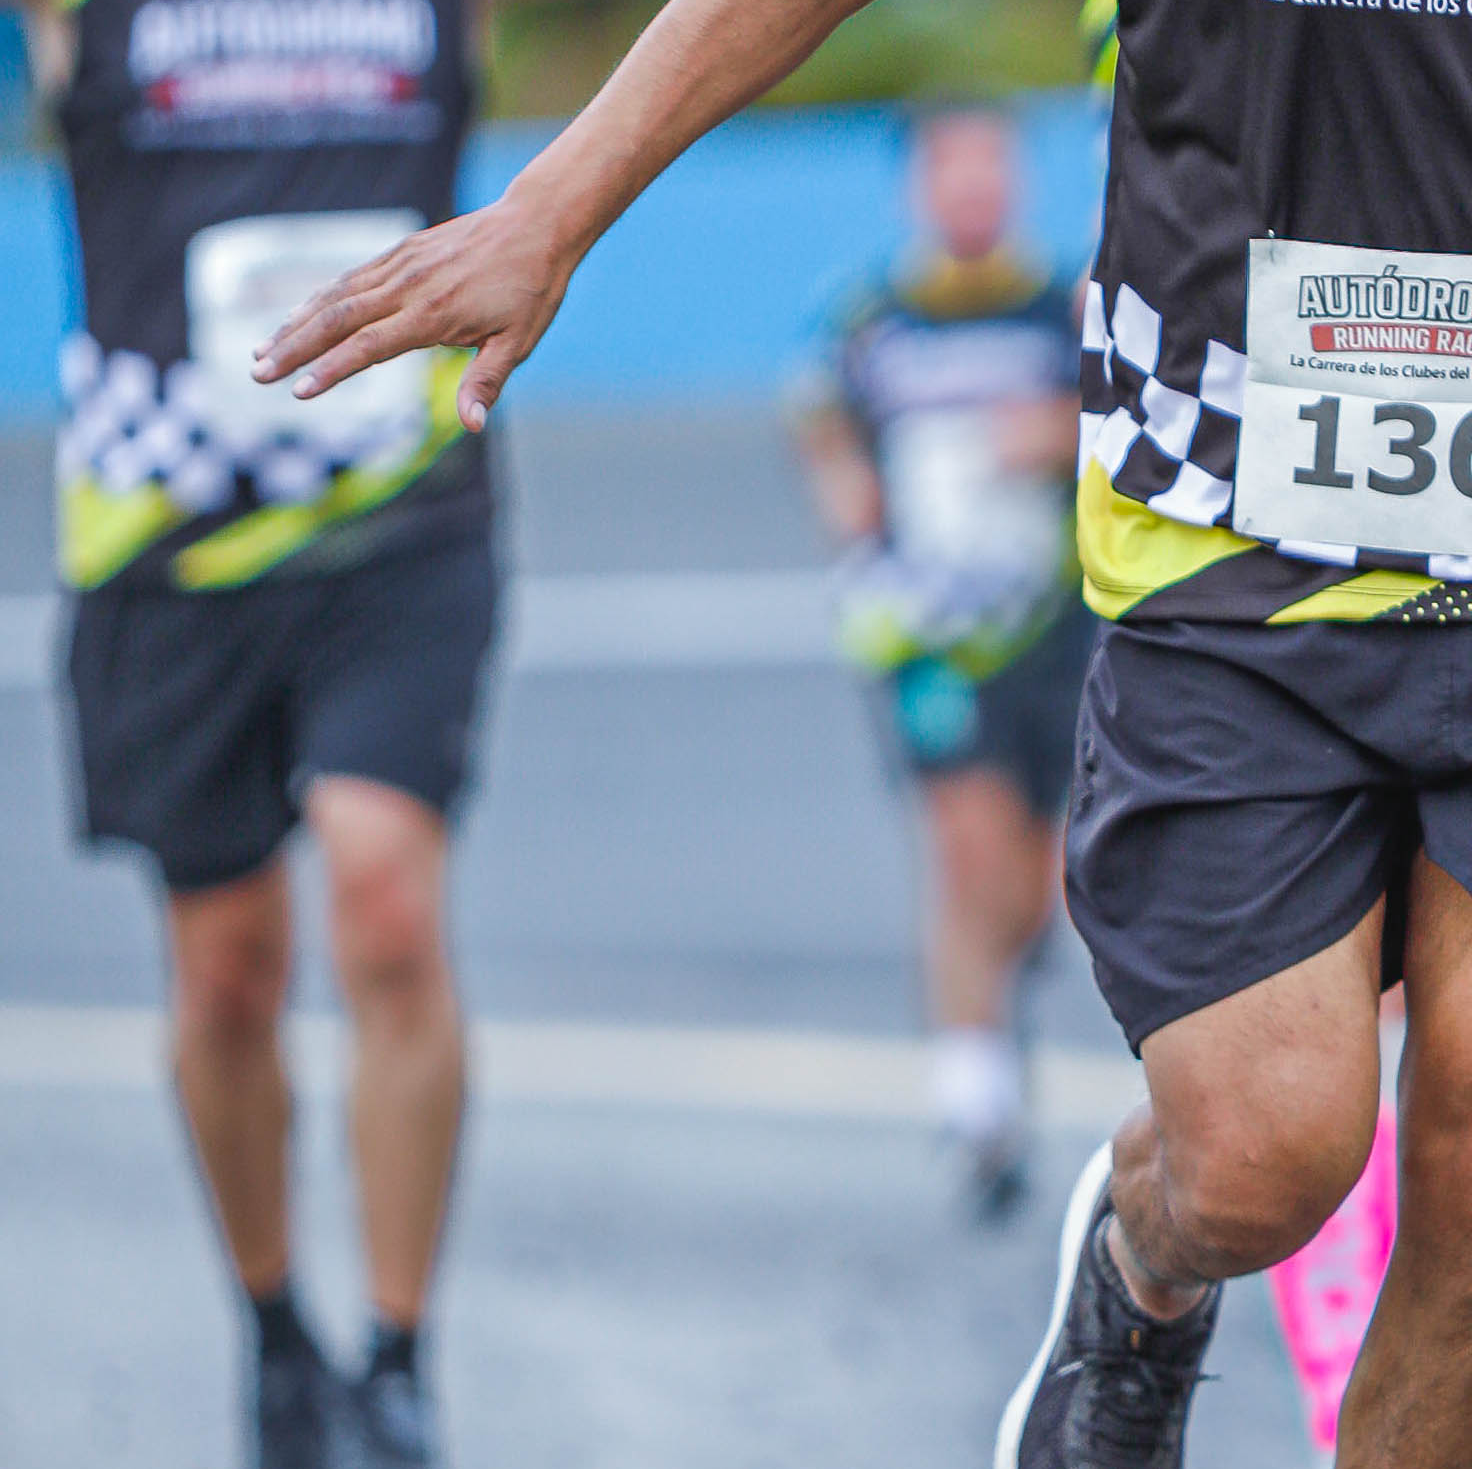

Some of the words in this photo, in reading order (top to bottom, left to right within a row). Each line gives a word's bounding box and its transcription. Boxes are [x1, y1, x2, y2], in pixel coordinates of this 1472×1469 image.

[1333, 327, 1430, 352] RUNNING
[1290, 354, 1305, 367] La
[1308, 356, 1356, 374] Carrera
[1359, 362, 1376, 375] de
[1379, 363, 1399, 377] los
[1402, 365, 1446, 380] Clubes
[1449, 367, 1470, 380] del
